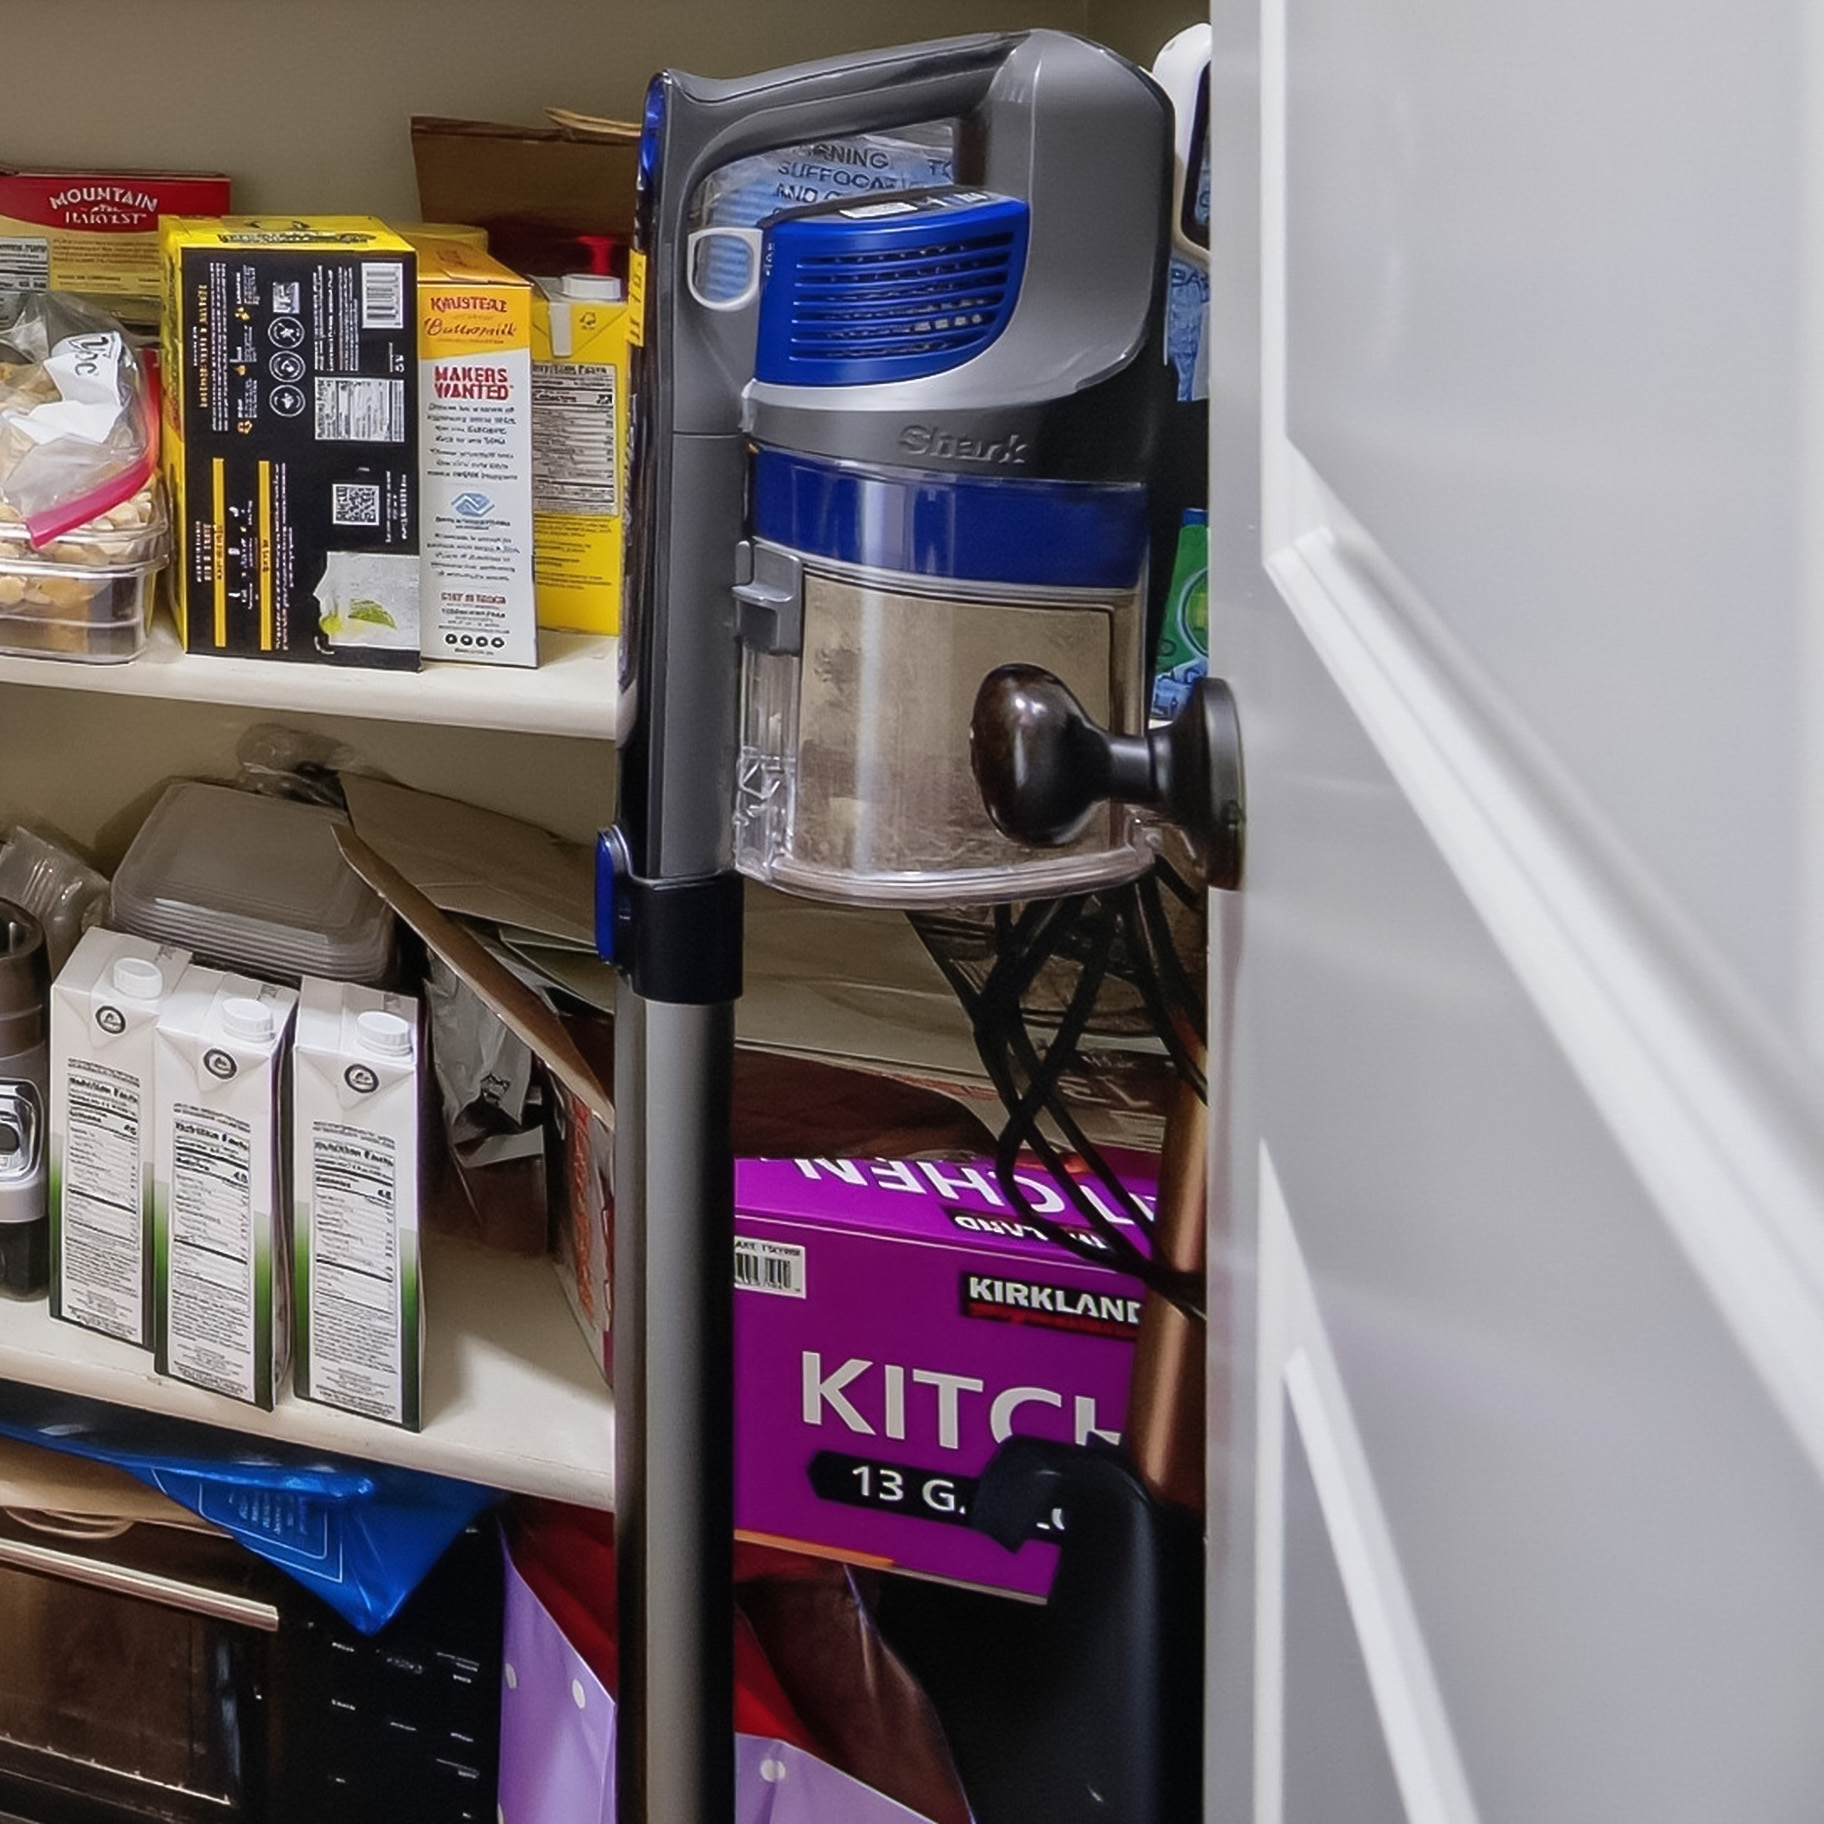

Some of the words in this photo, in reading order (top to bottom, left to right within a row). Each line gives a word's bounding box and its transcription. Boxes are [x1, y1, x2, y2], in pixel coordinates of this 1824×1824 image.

[49, 185, 159, 213] MOUNTAIN
[433, 365, 509, 386] MAKERS
[433, 380, 510, 400] WANTED
[898, 422, 1033, 467] Shark
[800, 1350, 1121, 1450] KITC
[852, 1464, 904, 1503] 13
